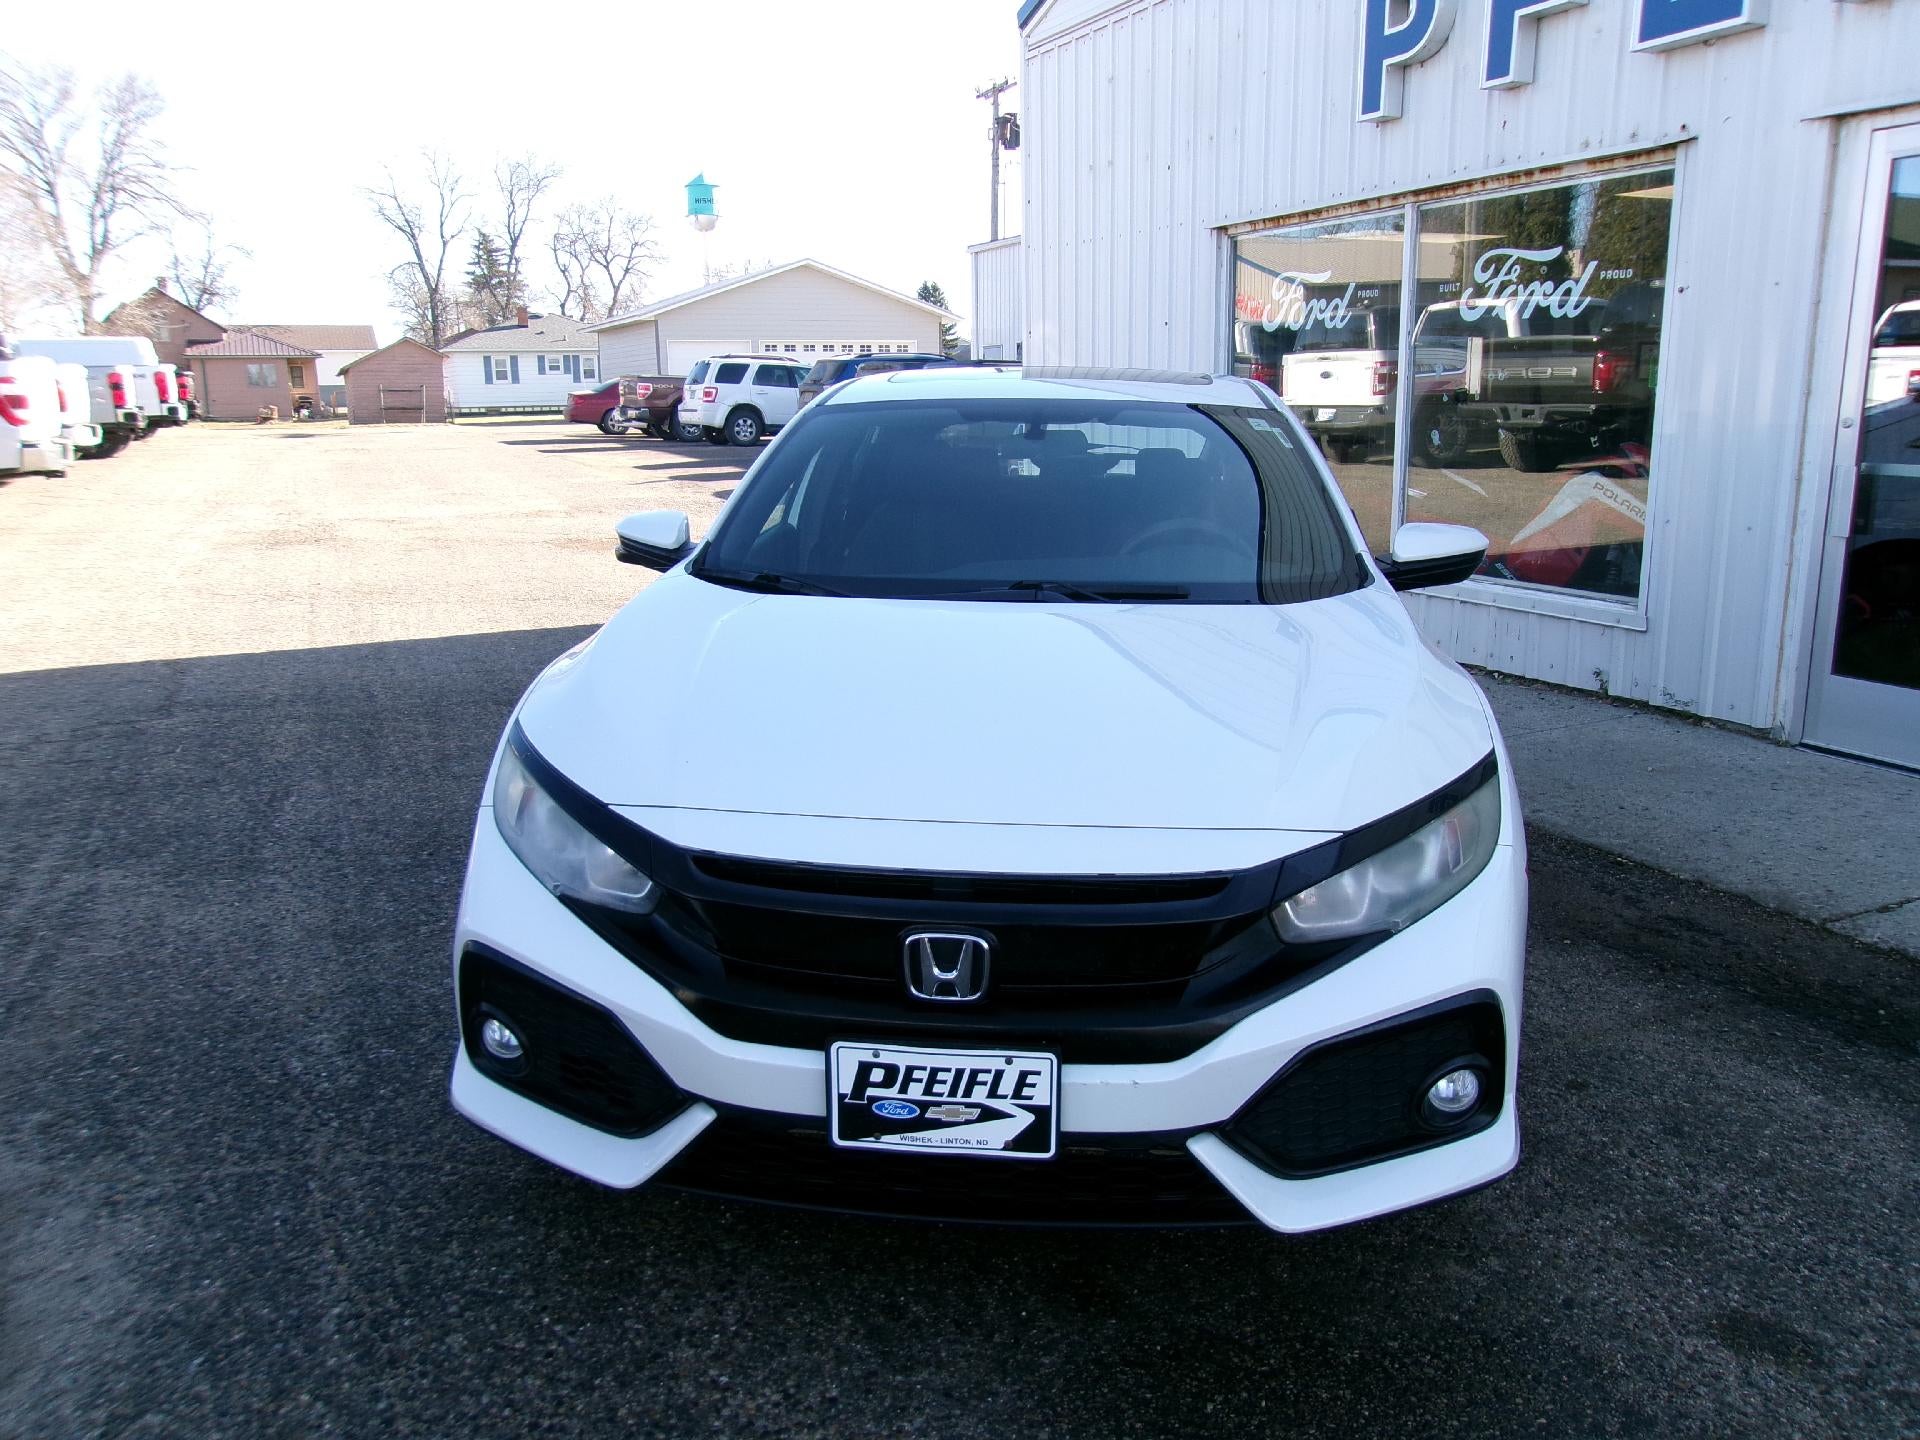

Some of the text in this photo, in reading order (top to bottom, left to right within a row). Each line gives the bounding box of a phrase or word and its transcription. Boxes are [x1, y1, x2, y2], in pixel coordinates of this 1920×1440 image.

[1262, 270, 1356, 332] Ford
[1357, 289, 1379, 298] PROUD
[1459, 245, 1599, 323] Ford
[1599, 268, 1633, 280] PROUD
[845, 1060, 1042, 1103] PFEIFLE
[881, 1101, 909, 1116] Ford
[900, 1134, 933, 1144] WISHEK
[940, 1138, 973, 1146] LINTON,
